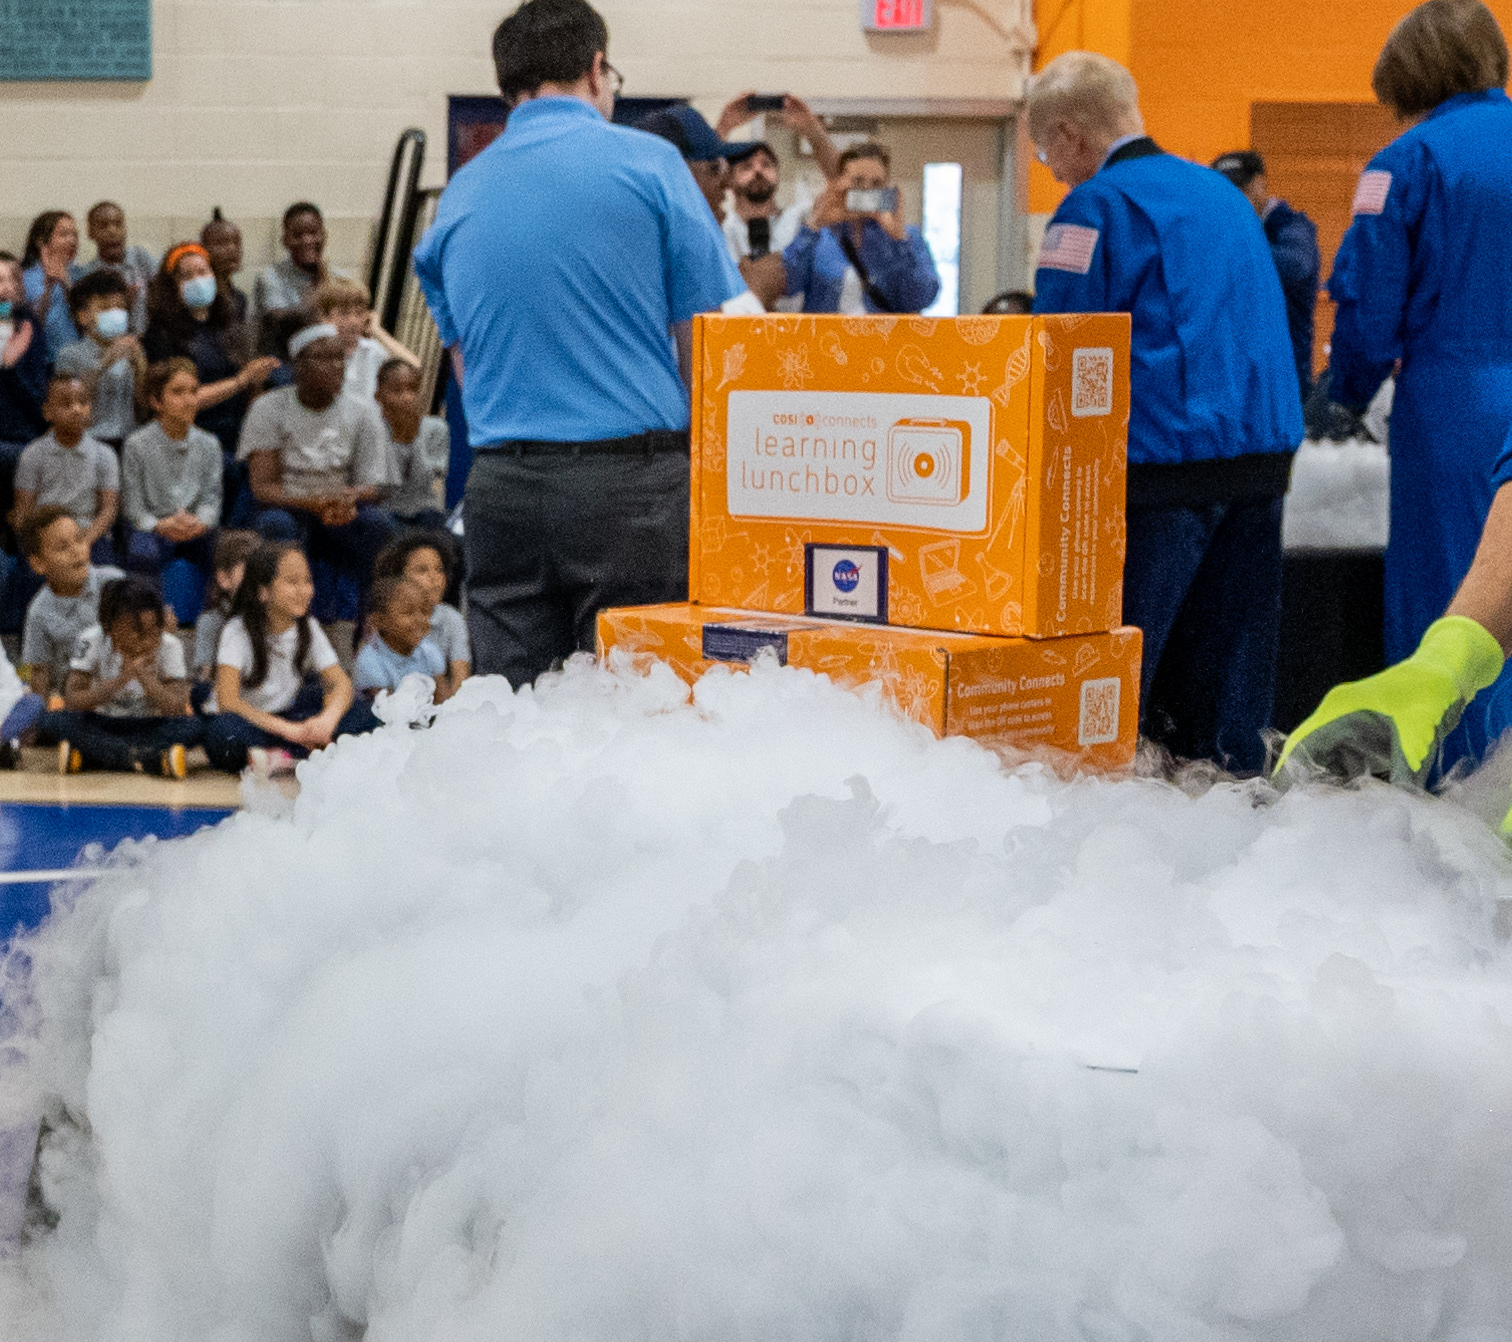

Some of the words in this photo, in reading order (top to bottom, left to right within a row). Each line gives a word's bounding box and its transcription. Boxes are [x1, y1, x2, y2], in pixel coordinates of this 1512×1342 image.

[755, 427, 876, 471] learning
[742, 460, 875, 497] lunchbox
[1059, 445, 1073, 523] Connects
[834, 571, 858, 582] NASA
[1055, 526, 1071, 622] Community
[957, 677, 1018, 698] Community
[1019, 672, 1066, 691] Connects
